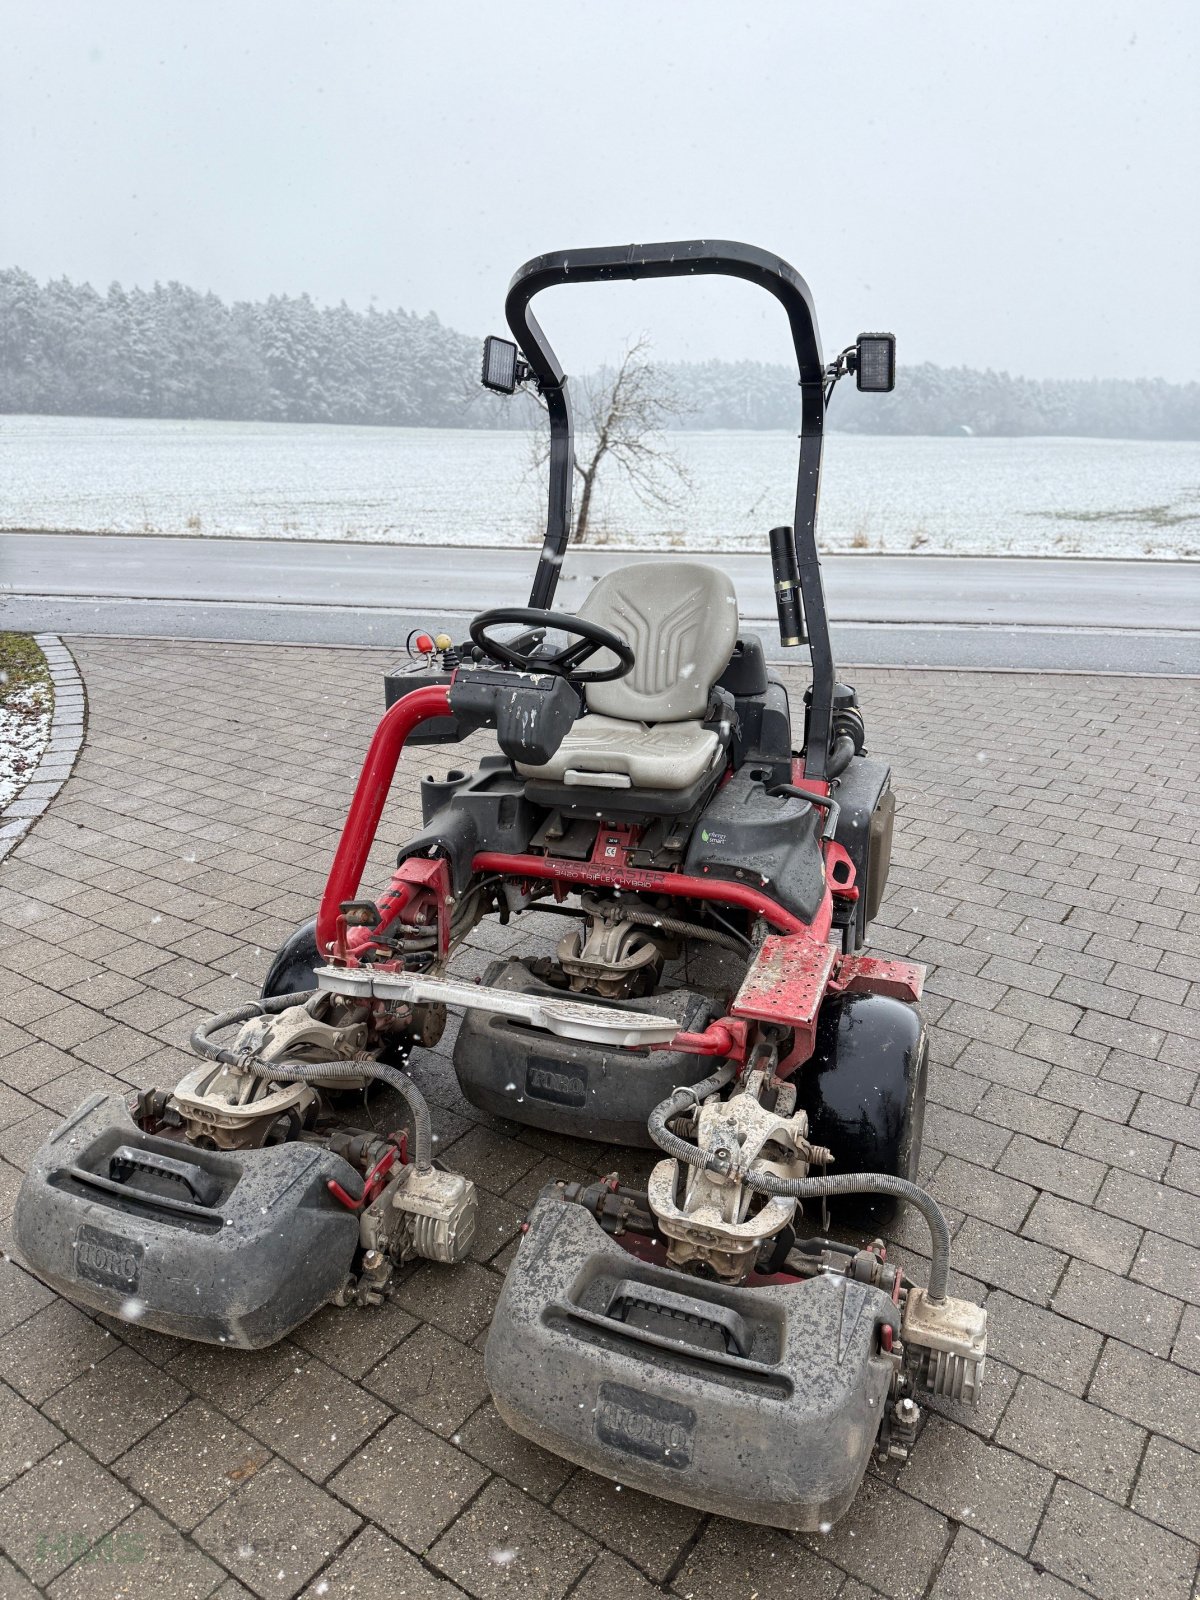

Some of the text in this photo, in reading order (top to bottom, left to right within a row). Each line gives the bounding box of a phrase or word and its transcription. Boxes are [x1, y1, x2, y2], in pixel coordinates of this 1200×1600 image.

[544, 860, 665, 883] GREENSMASTER
[555, 869, 579, 878] 3420
[620, 879, 652, 888] HYBRID
[528, 1067, 585, 1095] TORO
[78, 1241, 138, 1278] TORO
[601, 1400, 687, 1450] TORO
